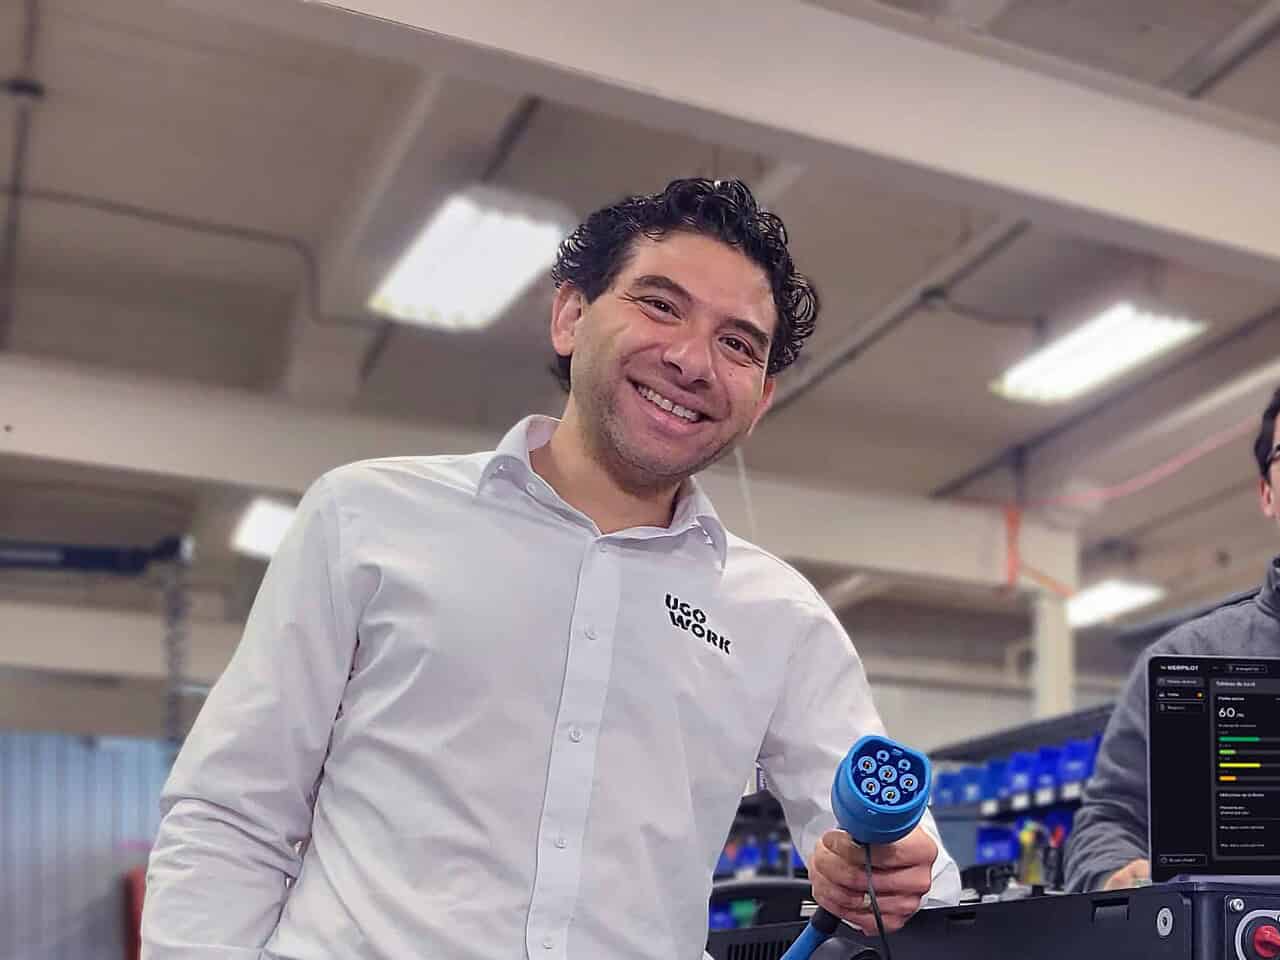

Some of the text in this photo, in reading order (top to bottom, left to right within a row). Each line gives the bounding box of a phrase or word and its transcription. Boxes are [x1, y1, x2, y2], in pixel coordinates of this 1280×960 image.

[665, 594, 706, 623] UGO
[669, 611, 731, 655] WORK
[1218, 707, 1236, 718] 60
